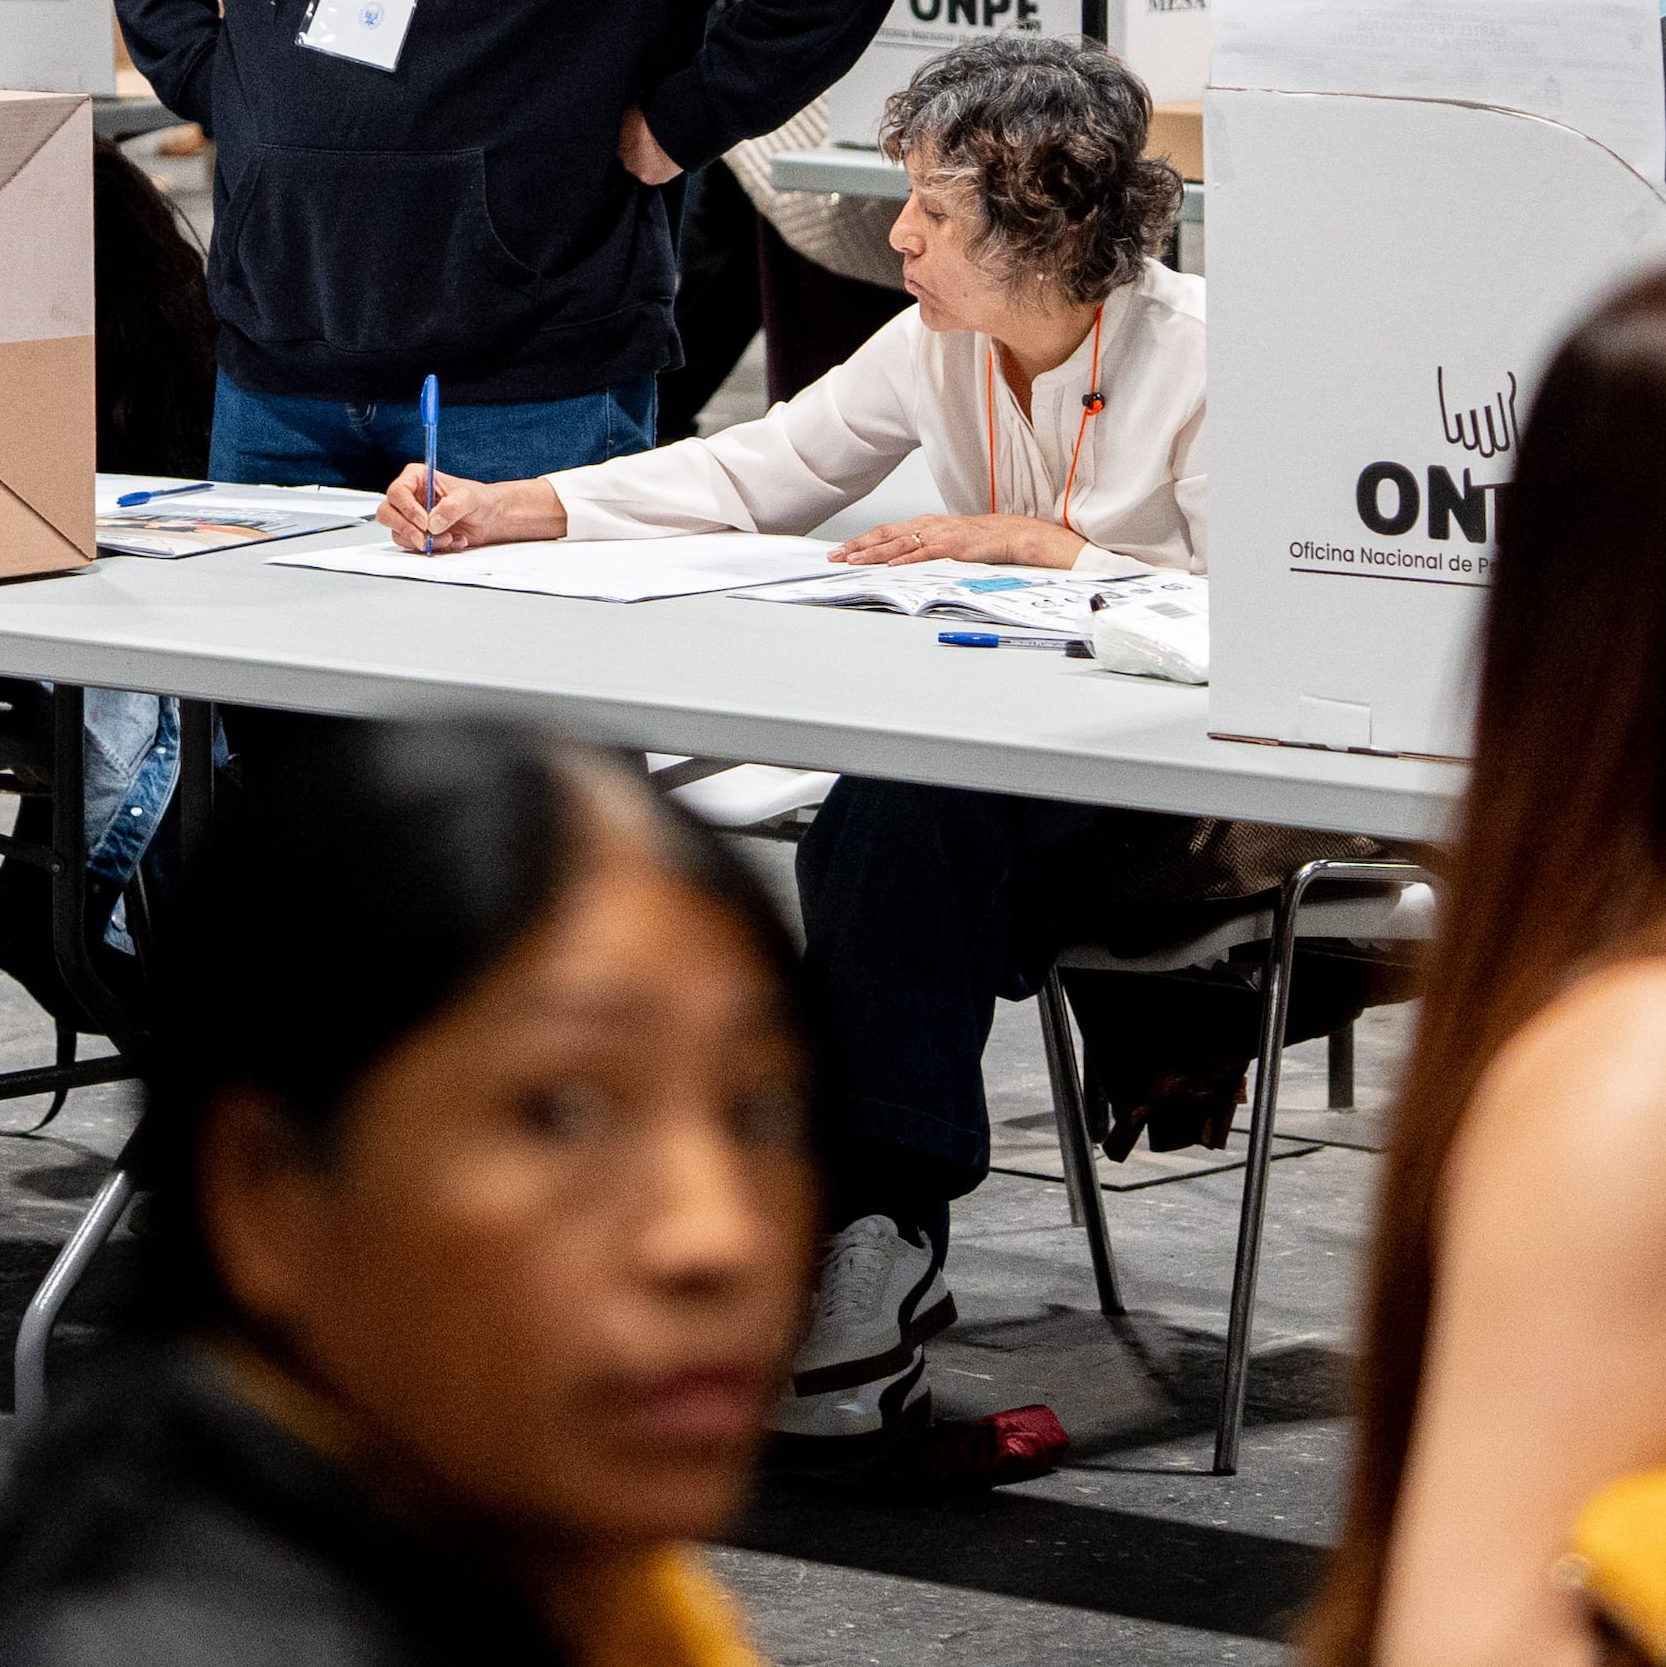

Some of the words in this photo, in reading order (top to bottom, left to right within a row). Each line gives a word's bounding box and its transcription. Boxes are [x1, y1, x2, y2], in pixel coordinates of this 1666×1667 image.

[1356, 461, 1494, 544] ON
[1289, 541, 1355, 563] Oficina
[1360, 547, 1443, 570] Nacional
[1448, 554, 1473, 573] de
